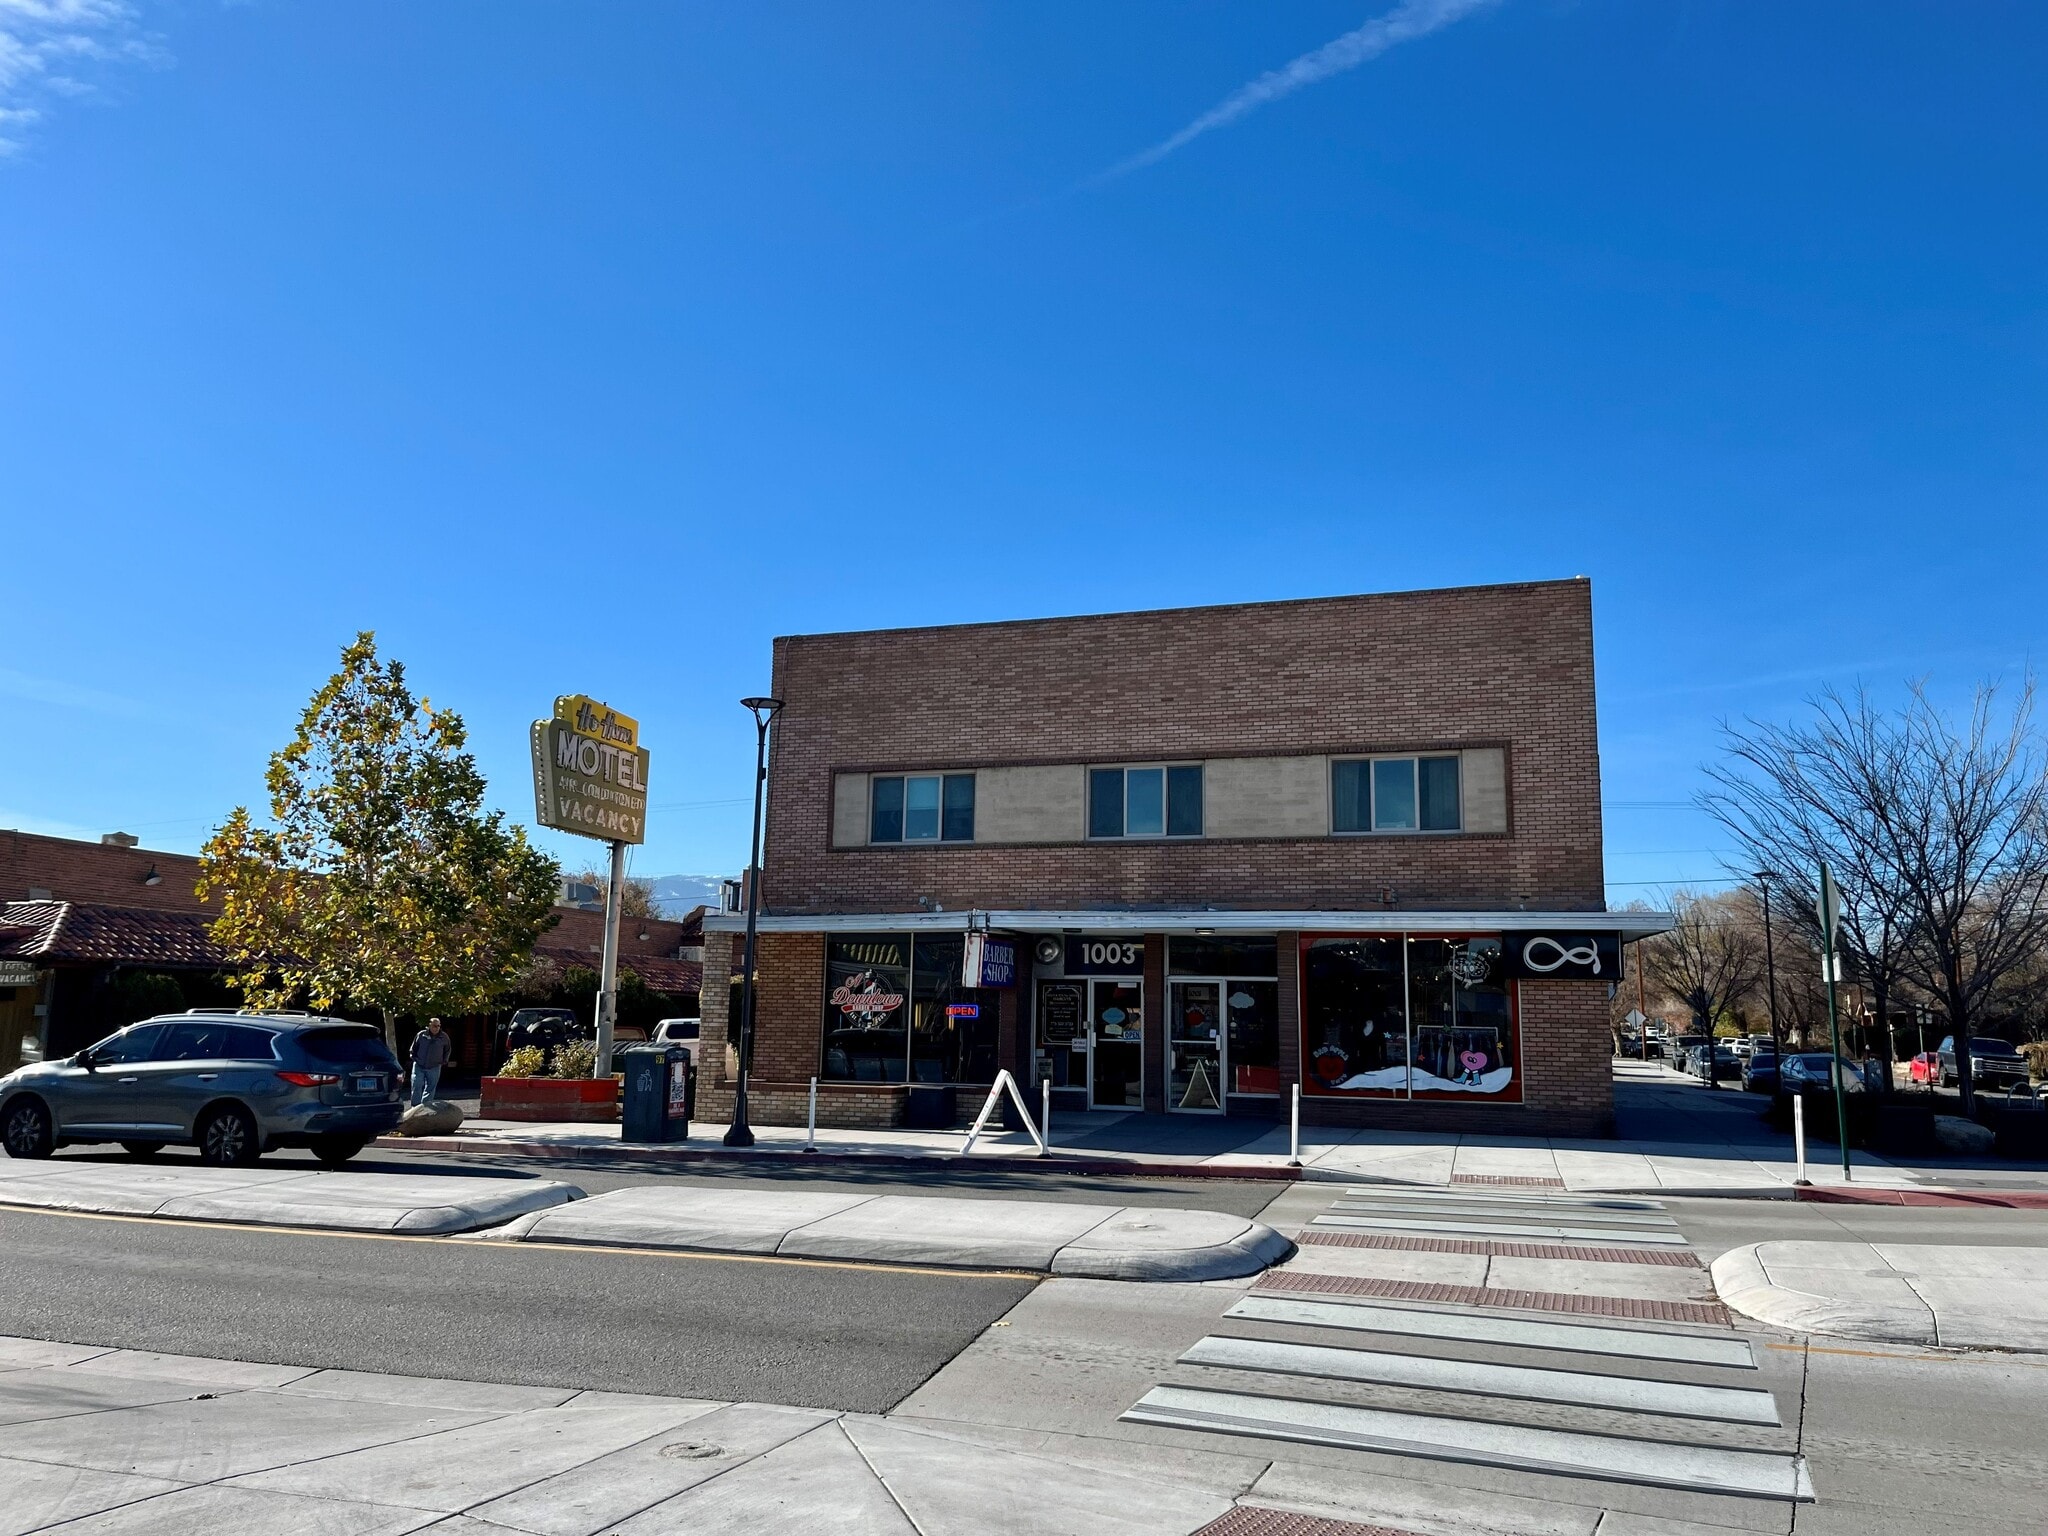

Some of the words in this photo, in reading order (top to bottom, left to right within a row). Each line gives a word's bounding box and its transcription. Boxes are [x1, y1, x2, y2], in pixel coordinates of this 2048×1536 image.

[557, 728, 647, 793] MOTEL
[559, 796, 641, 837] VACANCY
[984, 943, 1015, 966] BARBER
[1082, 942, 1136, 965] 1003
[987, 963, 1009, 983] SHOP
[829, 985, 904, 1005] Downtown
[945, 1006, 977, 1017] OPEN
[1125, 1030, 1141, 1039] OPEN
[656, 1055, 664, 1064] 97
